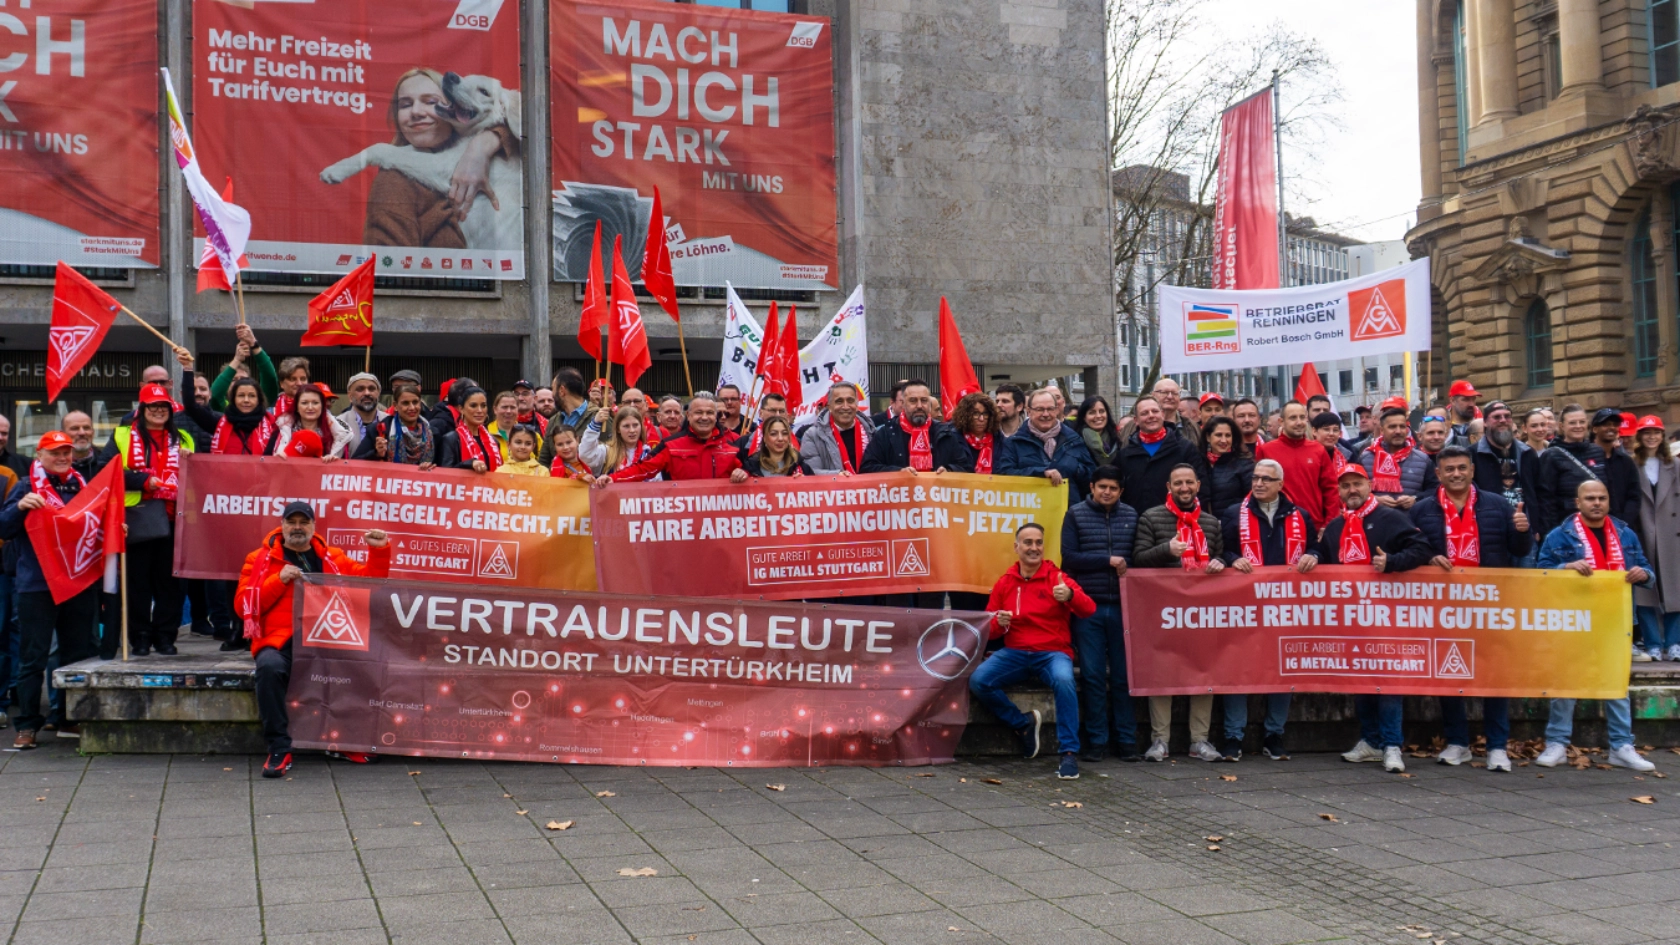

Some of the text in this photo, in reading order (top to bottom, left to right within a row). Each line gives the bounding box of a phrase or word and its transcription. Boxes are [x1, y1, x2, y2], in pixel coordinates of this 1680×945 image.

[455, 13, 489, 28] DGB
[208, 28, 372, 61] Mehr Freizeit
[602, 17, 739, 68] MACH
[790, 35, 814, 47] DGB
[207, 51, 365, 85] für Euch mit
[208, 78, 373, 115] Tarifvertrag.
[630, 63, 780, 128] DICH
[34, 132, 88, 155] UNS
[590, 120, 732, 167] STARK
[702, 170, 783, 194] MIT UNS
[686, 243, 731, 257] Löhne.
[1252, 308, 1336, 328] RENNINGEN
[739, 324, 762, 347] GU
[1246, 329, 1344, 346] Robert Bosch GmbH
[1187, 341, 1238, 353] BER-Rng
[320, 474, 533, 507] KEINE LIFESTYLE-FRAGE:
[619, 484, 1042, 515] MITBESTIMMUNG, TARIFVERTRÄGE & GUTE POLITIK:
[347, 499, 453, 530] GEREGELT,
[457, 509, 554, 537] GERECHT,
[557, 516, 593, 536] FLE
[629, 518, 695, 543] FAIRE
[699, 507, 949, 540] ARBEITSBEDINGUNGEN
[967, 511, 1035, 537] JETZT!
[332, 534, 356, 546] GUTE
[409, 539, 470, 555] GUTES LEBEN
[396, 554, 469, 570] STUTTGART
[752, 550, 811, 564] GUTE ARBEIT
[828, 546, 884, 560] GUTES LEBEN
[754, 561, 884, 580] IG METALL STUTTGART
[1254, 581, 1500, 602] WEIL DU ES VERDIENT HAST:
[390, 593, 896, 654] VERTRAUENSLEUTE
[1160, 599, 1592, 632] SICHERE RENTE FÜR EIN GUTES LEBEN
[1285, 642, 1346, 653] GUTE ARBEIT
[1365, 643, 1426, 655] GUTES LEBEN
[443, 644, 853, 684] STANDORT UNTERTÜRKHEIM
[1285, 657, 1426, 672] IG METALL STUTTGART
[369, 699, 424, 711] Bad Cannstatt
[458, 707, 513, 717] Untertürkheim
[539, 744, 602, 754] Rommelshausen
